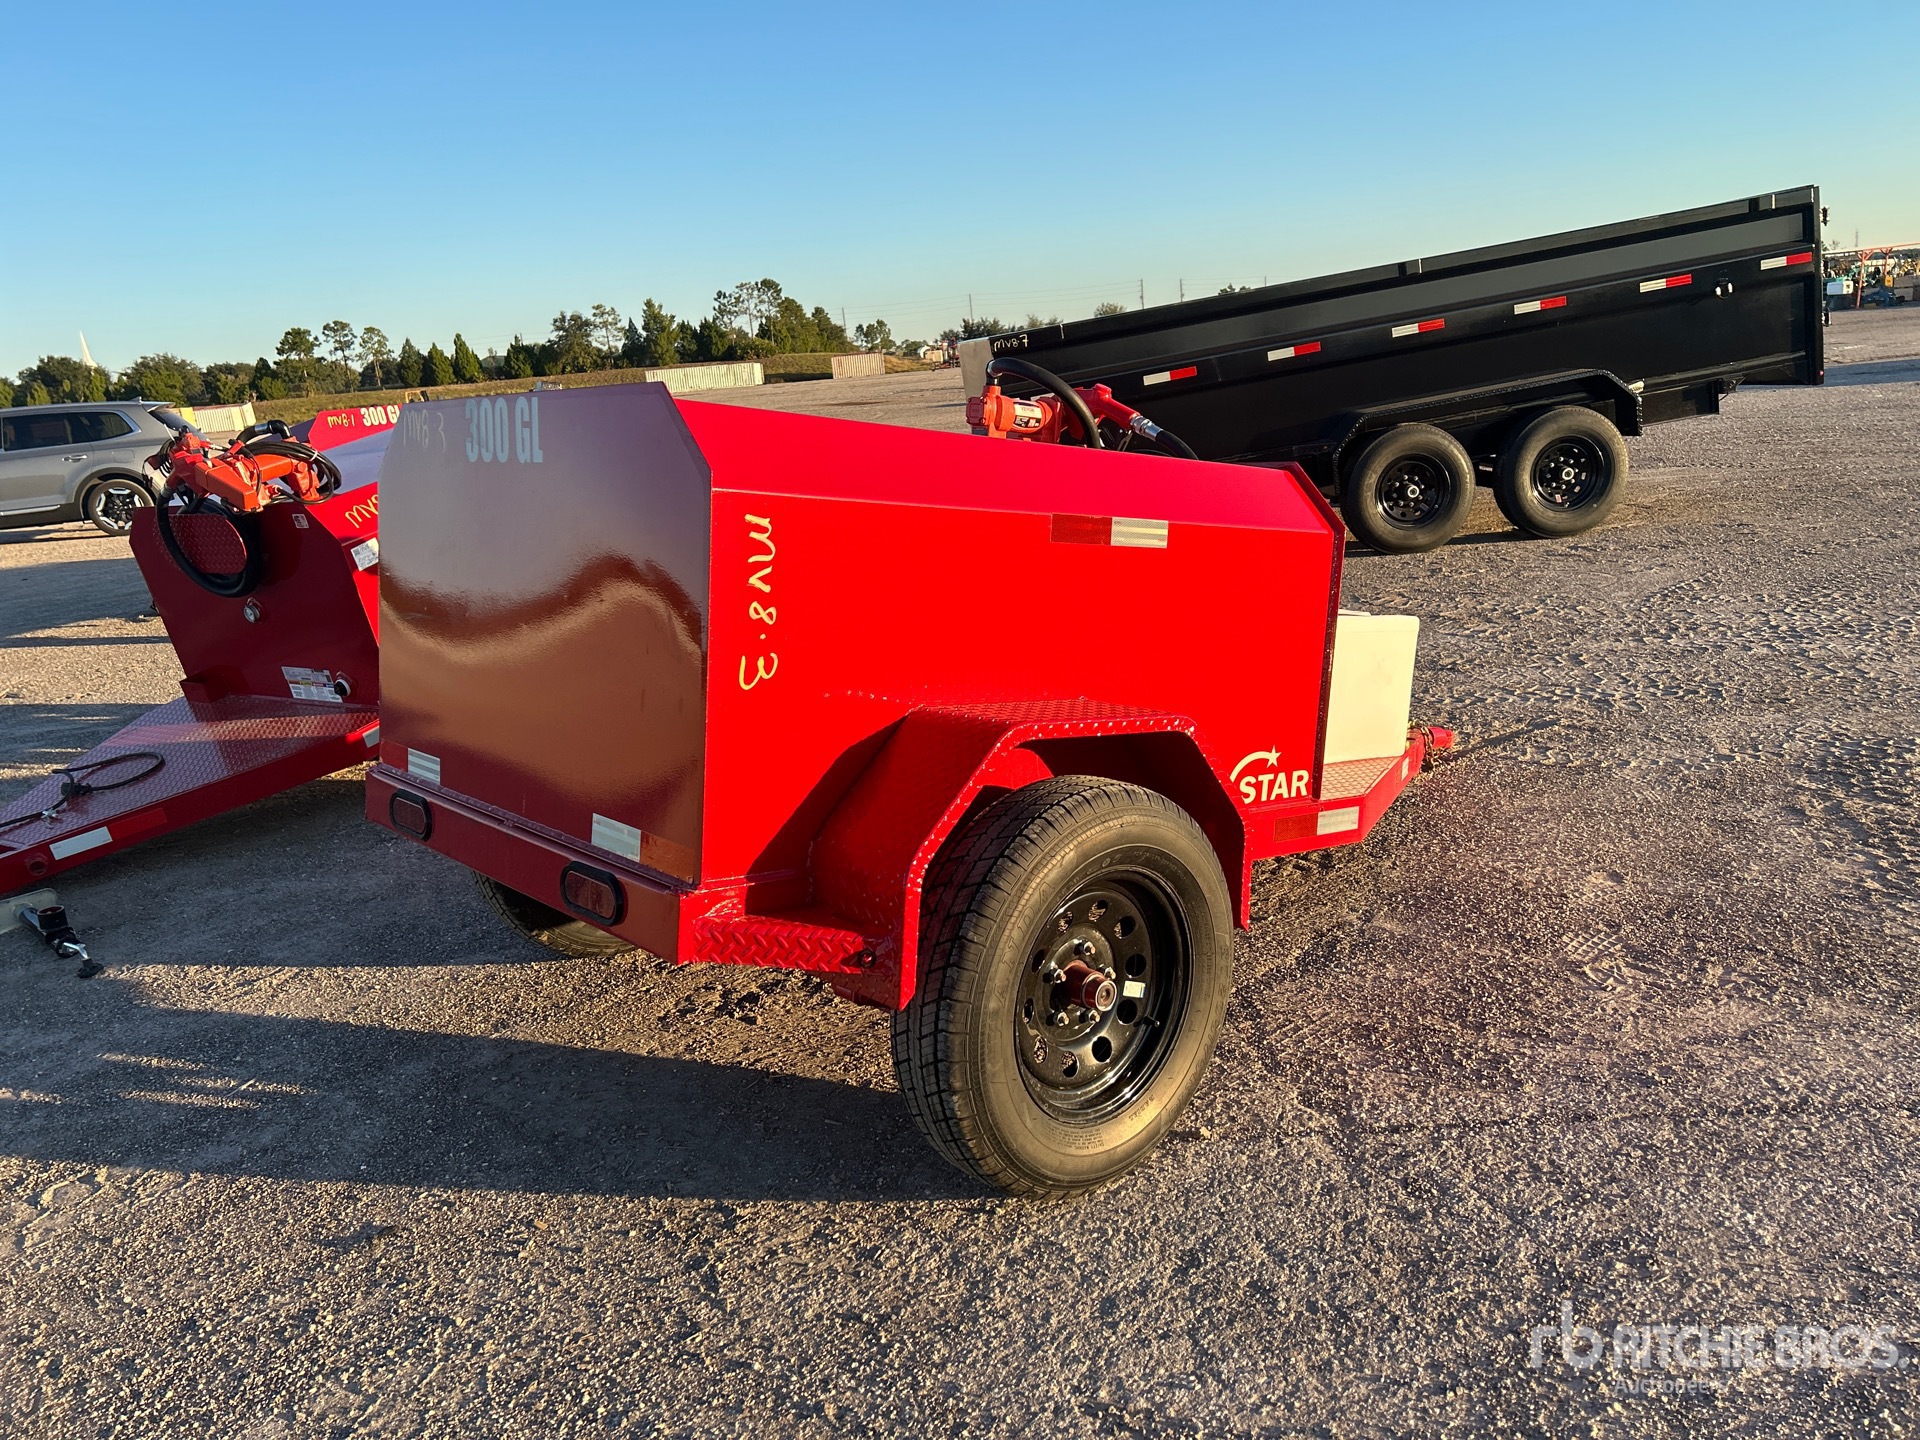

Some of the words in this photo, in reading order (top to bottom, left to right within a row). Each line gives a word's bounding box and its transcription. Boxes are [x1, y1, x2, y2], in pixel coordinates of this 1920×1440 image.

[360, 405, 387, 427] 300
[465, 397, 509, 463] 300
[515, 396, 543, 464] GL
[1239, 769, 1310, 804] STAR
